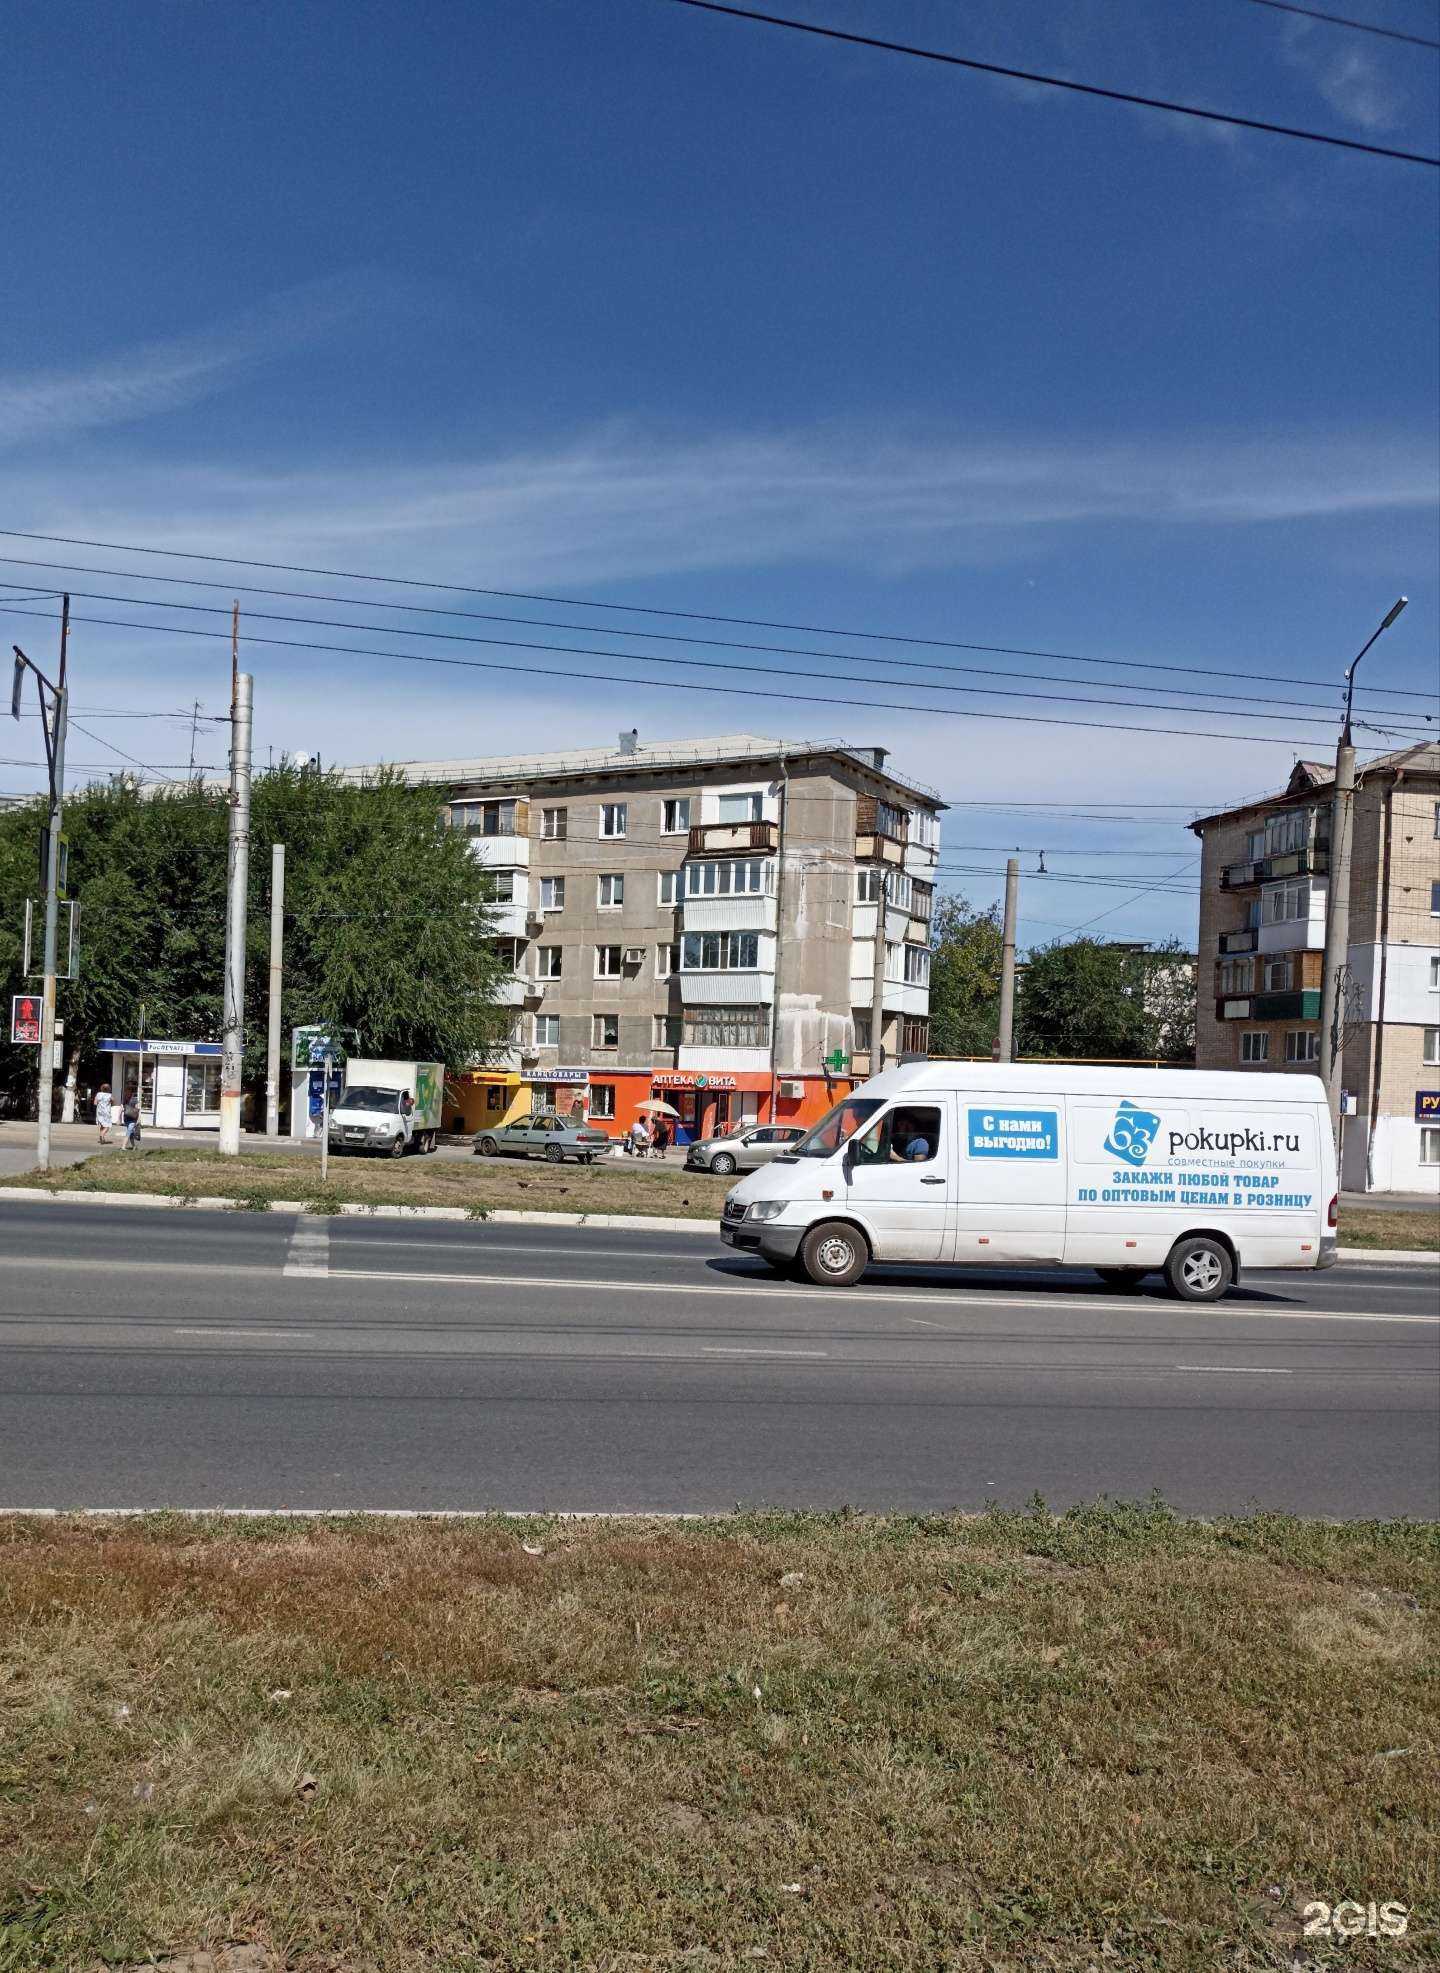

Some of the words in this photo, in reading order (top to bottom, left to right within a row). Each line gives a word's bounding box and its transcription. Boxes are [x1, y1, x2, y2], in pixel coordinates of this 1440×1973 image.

[652, 1075, 694, 1085] АПТЕКА
[708, 1076, 736, 1086] ВИТА
[983, 1115, 995, 1131] С
[998, 1119, 1043, 1133] нами
[974, 1134, 1052, 1152] выгодно!
[1108, 1116, 1152, 1159] 63
[1168, 1127, 1300, 1156] pokupki.ru
[1167, 1158, 1236, 1168] совместные
[1240, 1160, 1286, 1170] покупки
[1112, 1171, 1173, 1185] ЗАКАЖИ
[1177, 1172, 1230, 1187] ЛЮБОЙ
[1233, 1175, 1279, 1188] ТОВАР
[1078, 1188, 1097, 1201] ПО
[1102, 1189, 1176, 1203] ОПТОВЫМ
[1180, 1191, 1230, 1205] ЦЕНАМ
[1233, 1193, 1243, 1205] В
[1247, 1193, 1312, 1208] РОЗНИЦУ
